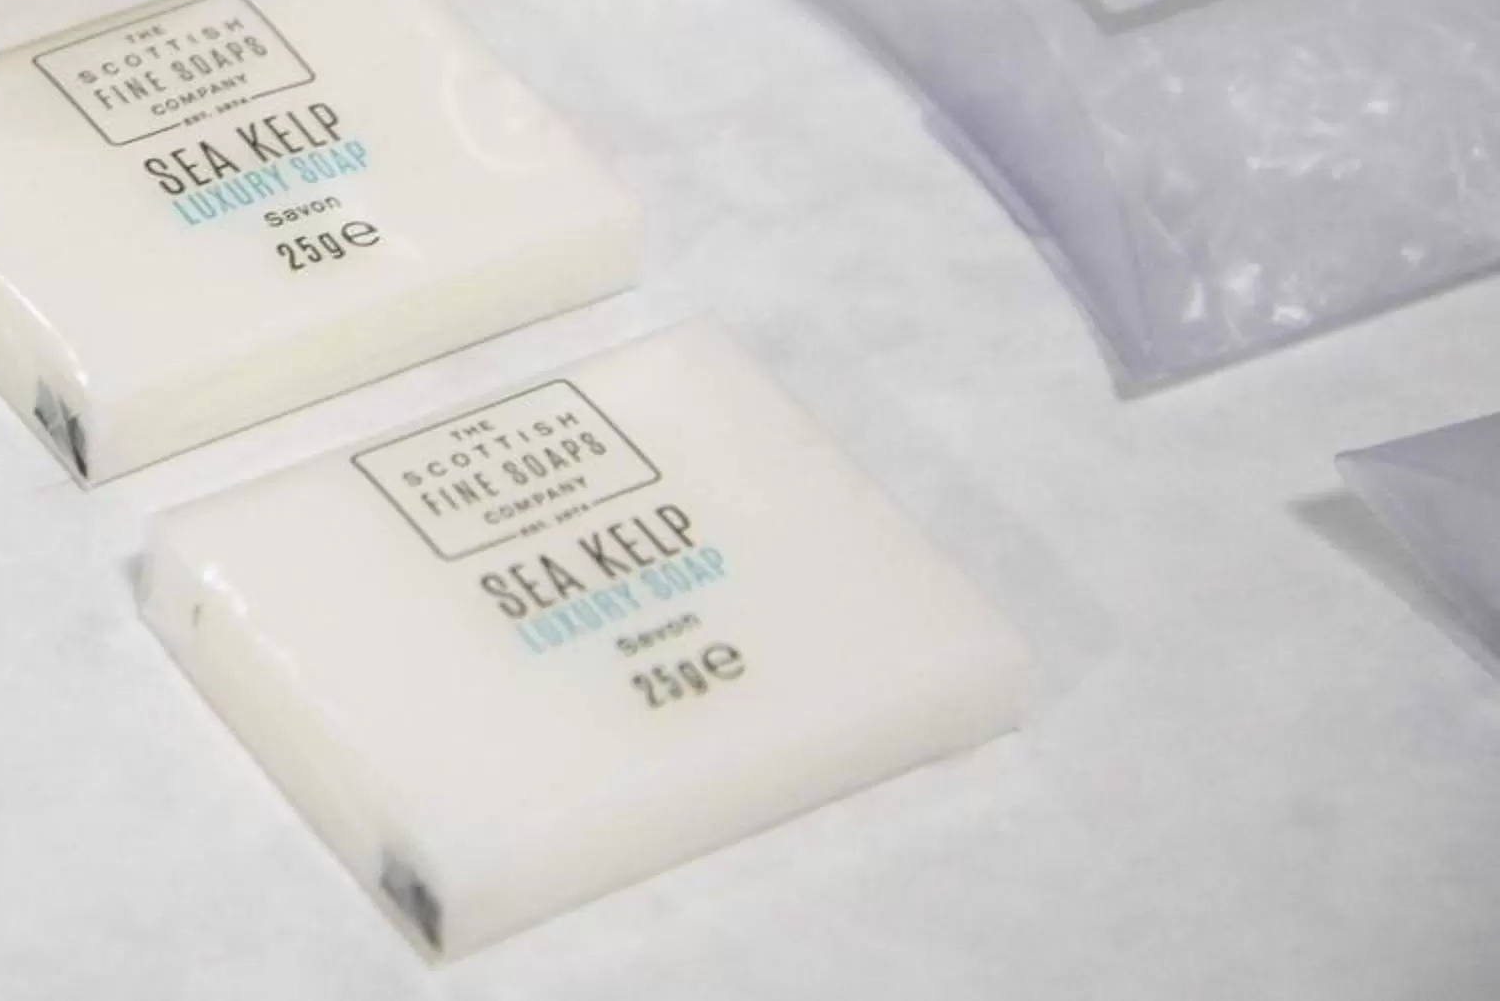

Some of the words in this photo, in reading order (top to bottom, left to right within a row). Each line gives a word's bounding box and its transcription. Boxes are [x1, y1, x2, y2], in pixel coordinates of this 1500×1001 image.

[77, 17, 245, 85] SCOTTISH
[125, 24, 168, 44] THE
[94, 70, 168, 111] FINE
[171, 35, 269, 83] SOAPS
[150, 72, 249, 117] COMPANY
[143, 139, 241, 196] SEA
[235, 101, 342, 164] KELP
[172, 162, 291, 227] LUXURY
[289, 139, 368, 185] SOAP
[263, 193, 343, 228] Savon
[402, 411, 580, 488] SCOTTISH
[448, 419, 497, 442] THE
[420, 471, 500, 517] FINE
[501, 430, 608, 486] SOAPS
[483, 474, 589, 525] COMPANY
[480, 553, 587, 620] SEA
[577, 503, 695, 579] KELP
[517, 581, 642, 655] LUXURY
[640, 544, 726, 600] SOAP
[614, 610, 701, 657] Savon
